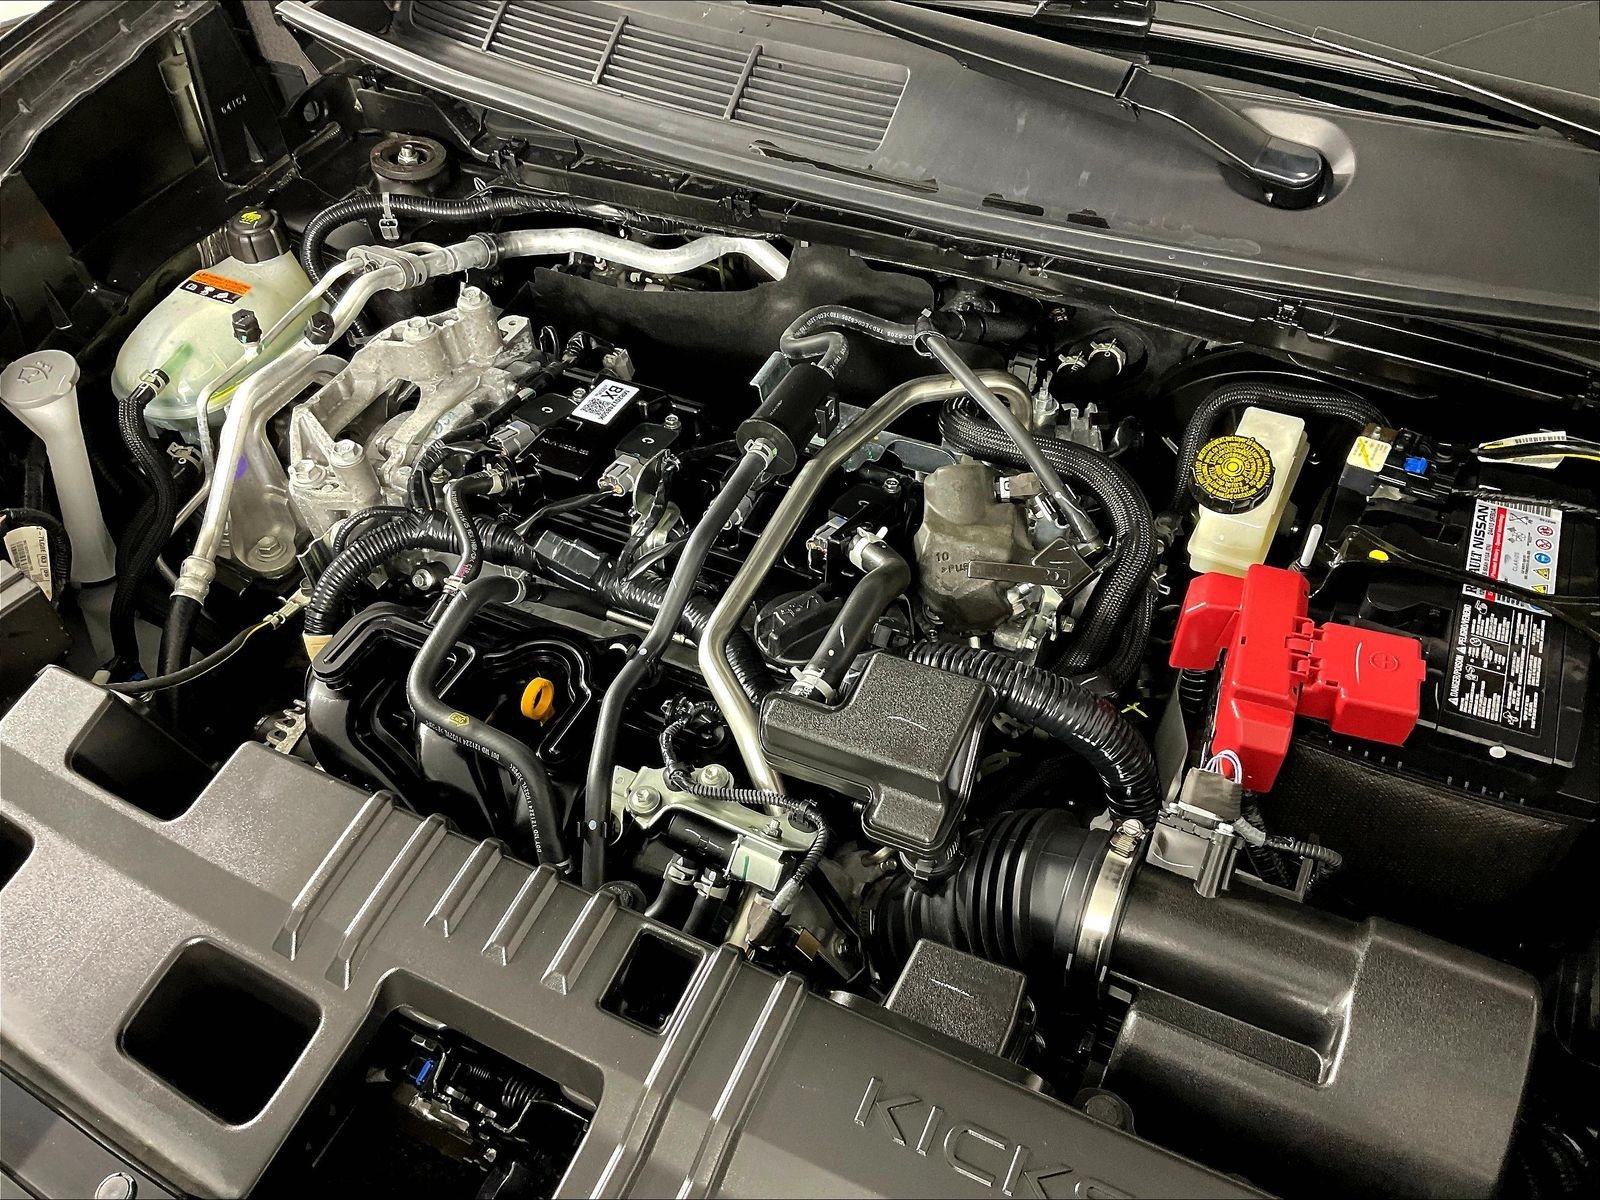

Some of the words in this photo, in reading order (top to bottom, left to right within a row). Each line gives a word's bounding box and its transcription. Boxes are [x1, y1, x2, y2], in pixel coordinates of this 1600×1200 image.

[600, 385, 624, 399] BX
[1472, 504, 1490, 550] NISSAN
[936, 552, 950, 562] 10
[1466, 549, 1483, 593] RAULT
